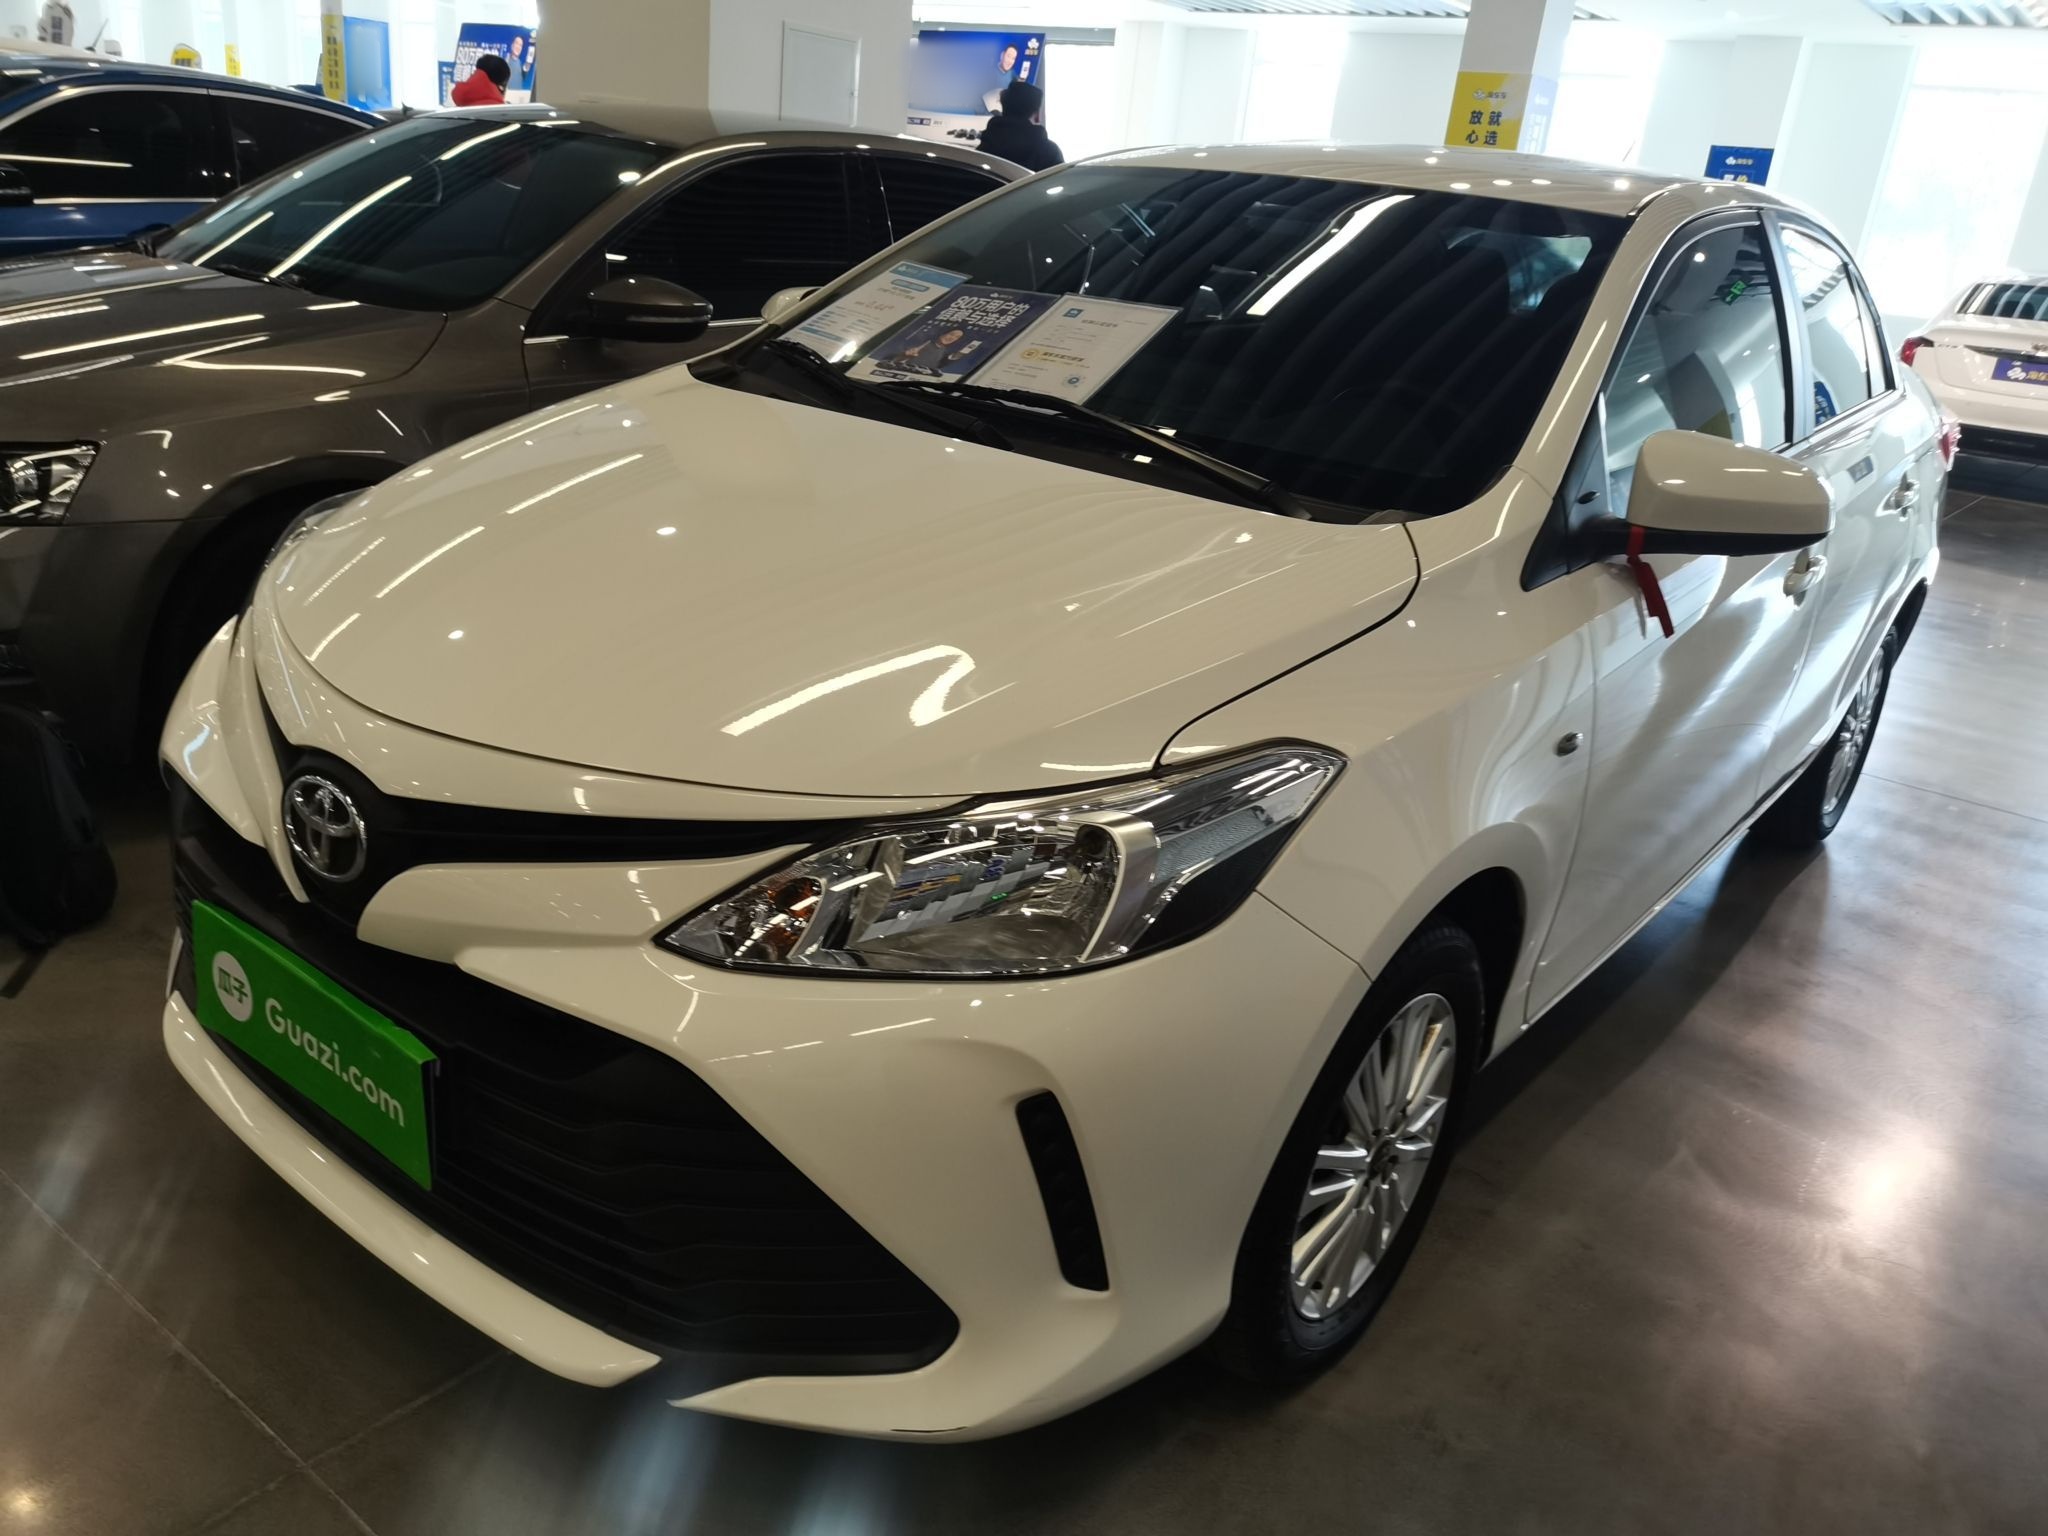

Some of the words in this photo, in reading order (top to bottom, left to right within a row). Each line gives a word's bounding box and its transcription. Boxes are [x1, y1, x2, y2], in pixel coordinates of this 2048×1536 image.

[950, 296, 1031, 316] 80万用户的
[217, 966, 249, 1005] 瓜子
[265, 997, 405, 1128] Guazi.com
